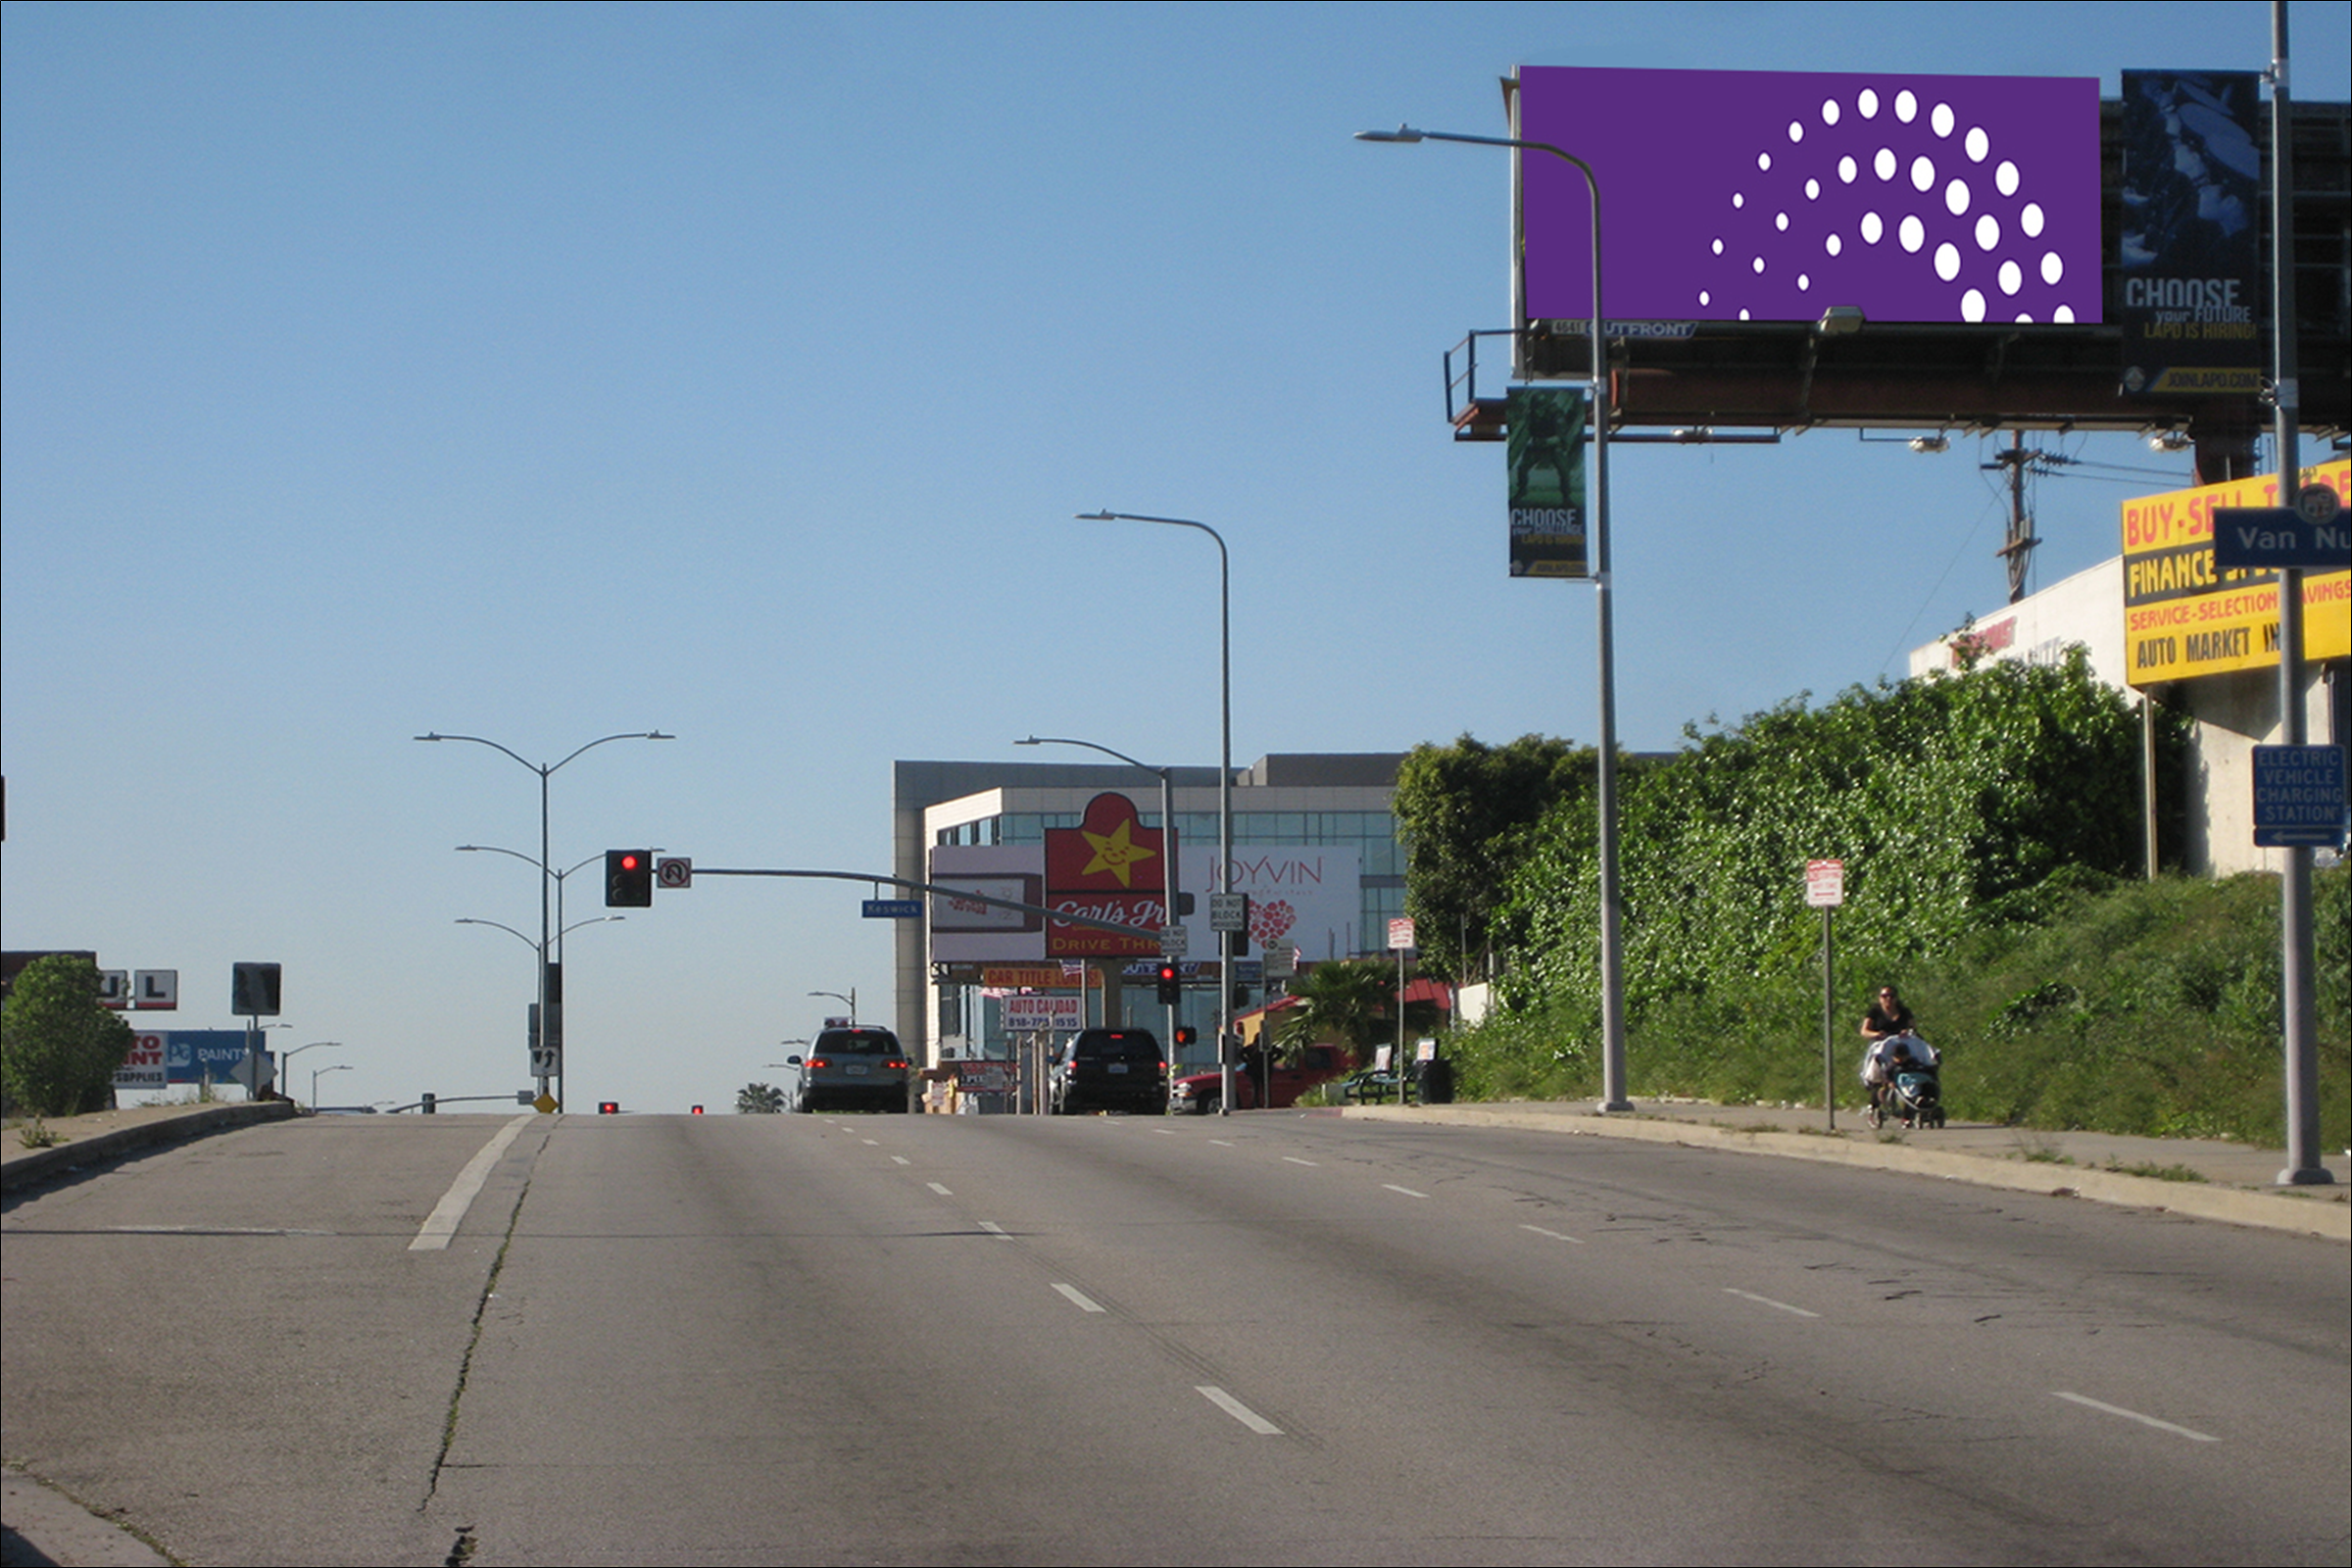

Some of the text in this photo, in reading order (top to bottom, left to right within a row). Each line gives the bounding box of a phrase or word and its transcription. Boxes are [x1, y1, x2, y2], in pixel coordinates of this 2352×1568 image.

[2126, 277, 2241, 308] CHOOSE
[2156, 306, 2252, 325] your FUTURE
[2144, 322, 2257, 339] LAPD IS HIRING!
[1510, 508, 1577, 526] CHOOSE
[2238, 526, 2296, 549] Van
[2130, 549, 2218, 599] FINANCE
[2136, 636, 2177, 668] AUTO
[2185, 626, 2251, 662] MARKET
[2258, 751, 2338, 766] ELECTRIC
[2264, 769, 2334, 784] VEHICLE
[2257, 787, 2342, 803] CHARGING
[2265, 806, 2337, 821] STATION
[1205, 856, 1322, 893] JOYVIN
[866, 904, 918, 913] Keswick
[1211, 899, 1242, 907] DO NOT
[1053, 900, 1128, 927] Carl's
[1211, 910, 1242, 919] BLOCK
[1052, 937, 1160, 951] DRIVE THR
[988, 968, 1102, 985] CAR TITLE LOAS!
[1008, 999, 1078, 1013] AUTO CALIDAD
[131, 1035, 161, 1050] TO
